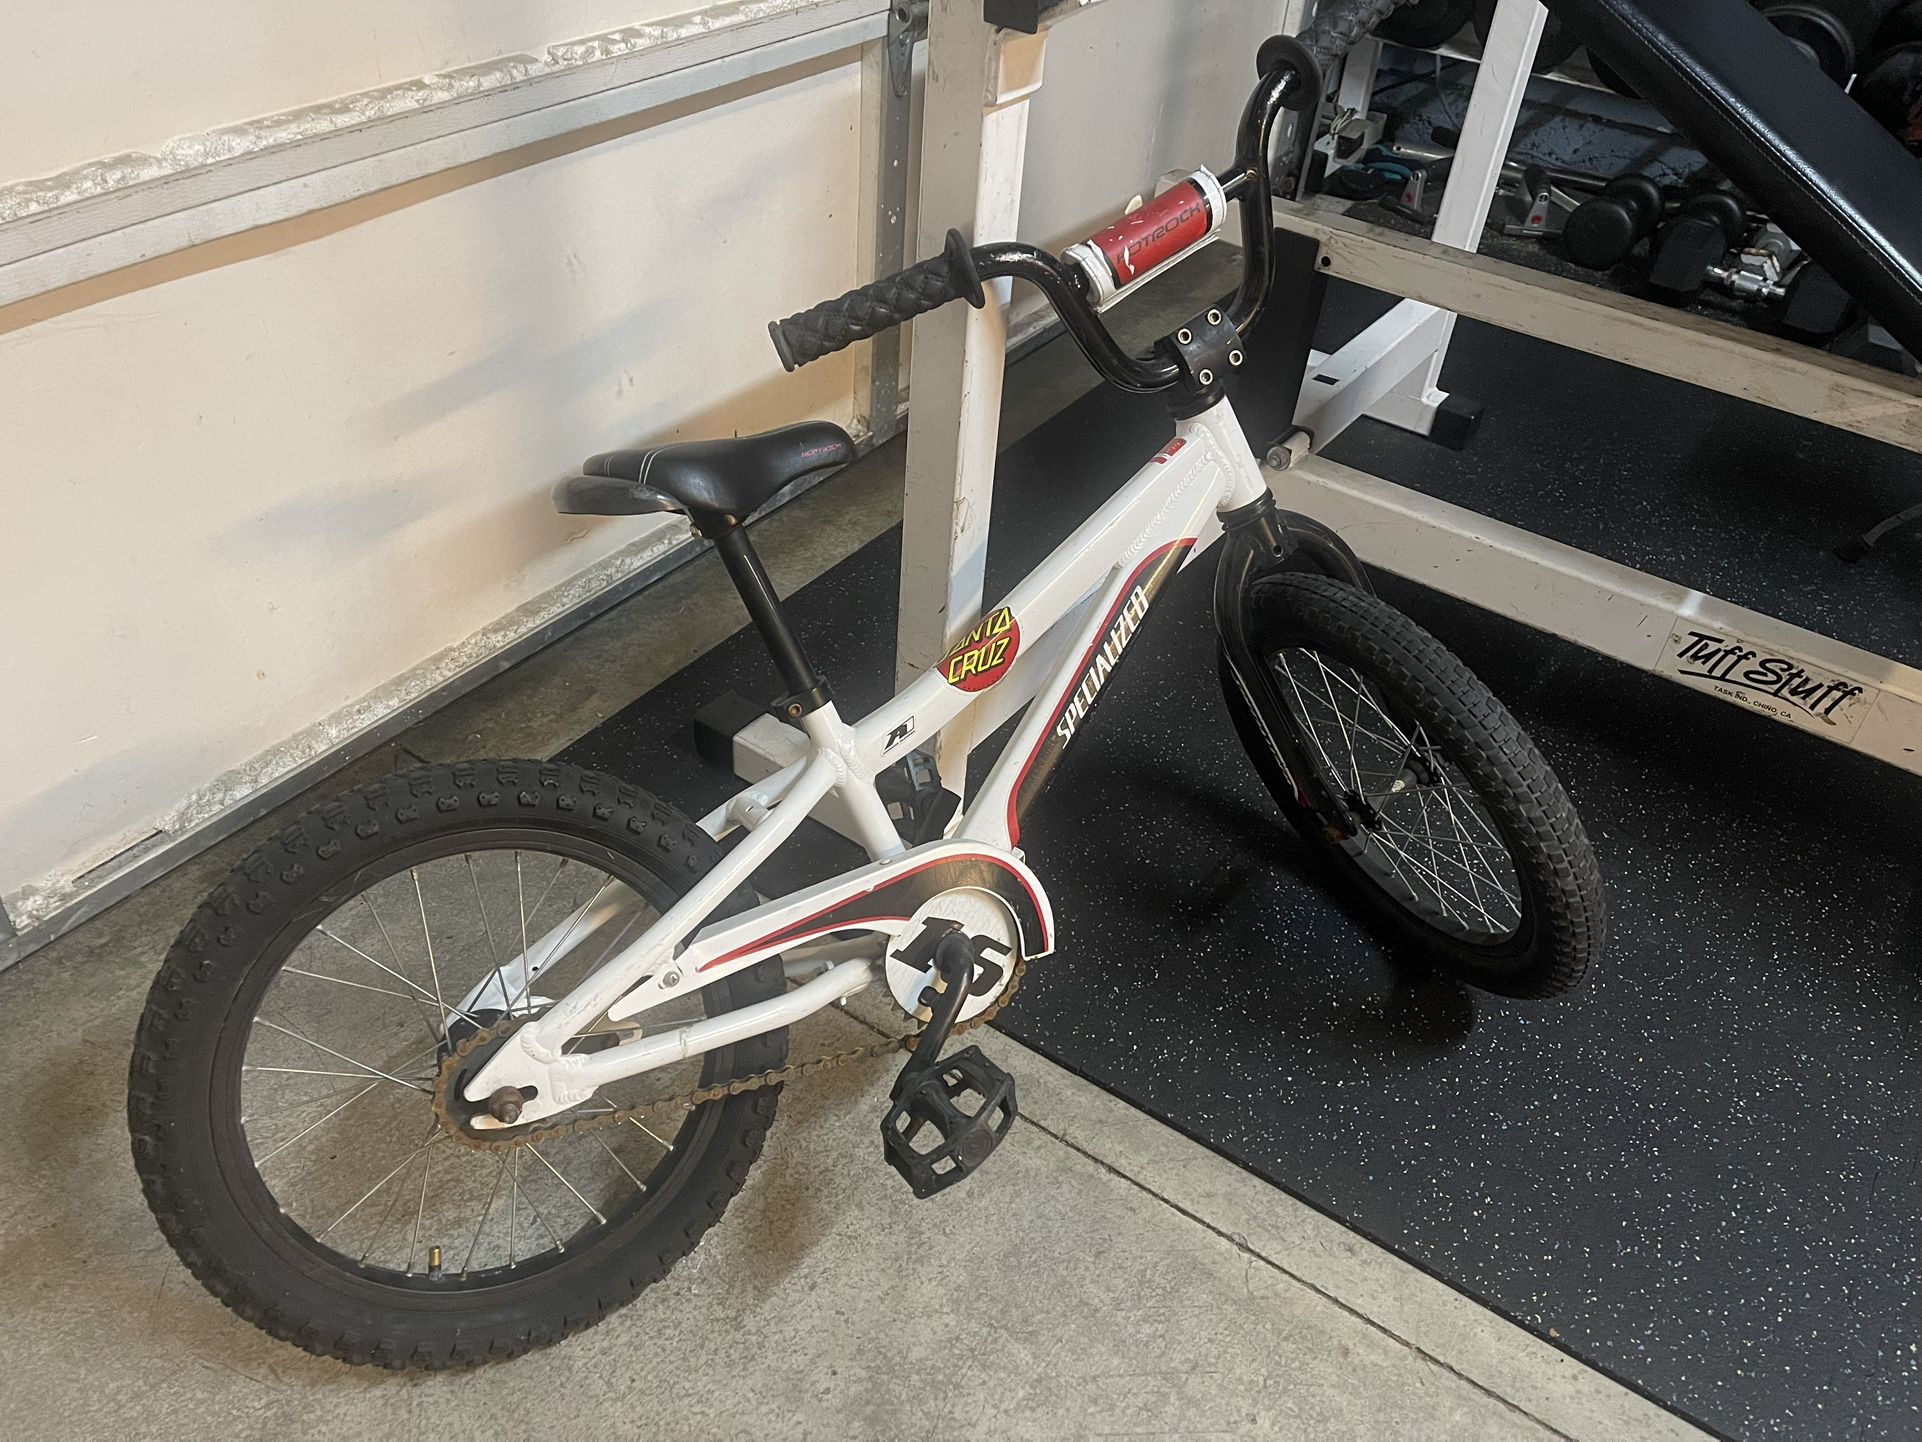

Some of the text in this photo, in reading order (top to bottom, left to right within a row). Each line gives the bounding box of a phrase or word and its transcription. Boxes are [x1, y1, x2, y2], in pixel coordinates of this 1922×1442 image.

[949, 606, 1012, 652] ANTA
[947, 636, 1012, 685] CRUZ
[1056, 584, 1150, 750] SPECIALIZED
[1677, 631, 1864, 717] Tuff Stuff
[1713, 685, 1734, 698] TASK
[1780, 710, 1792, 719] CA
